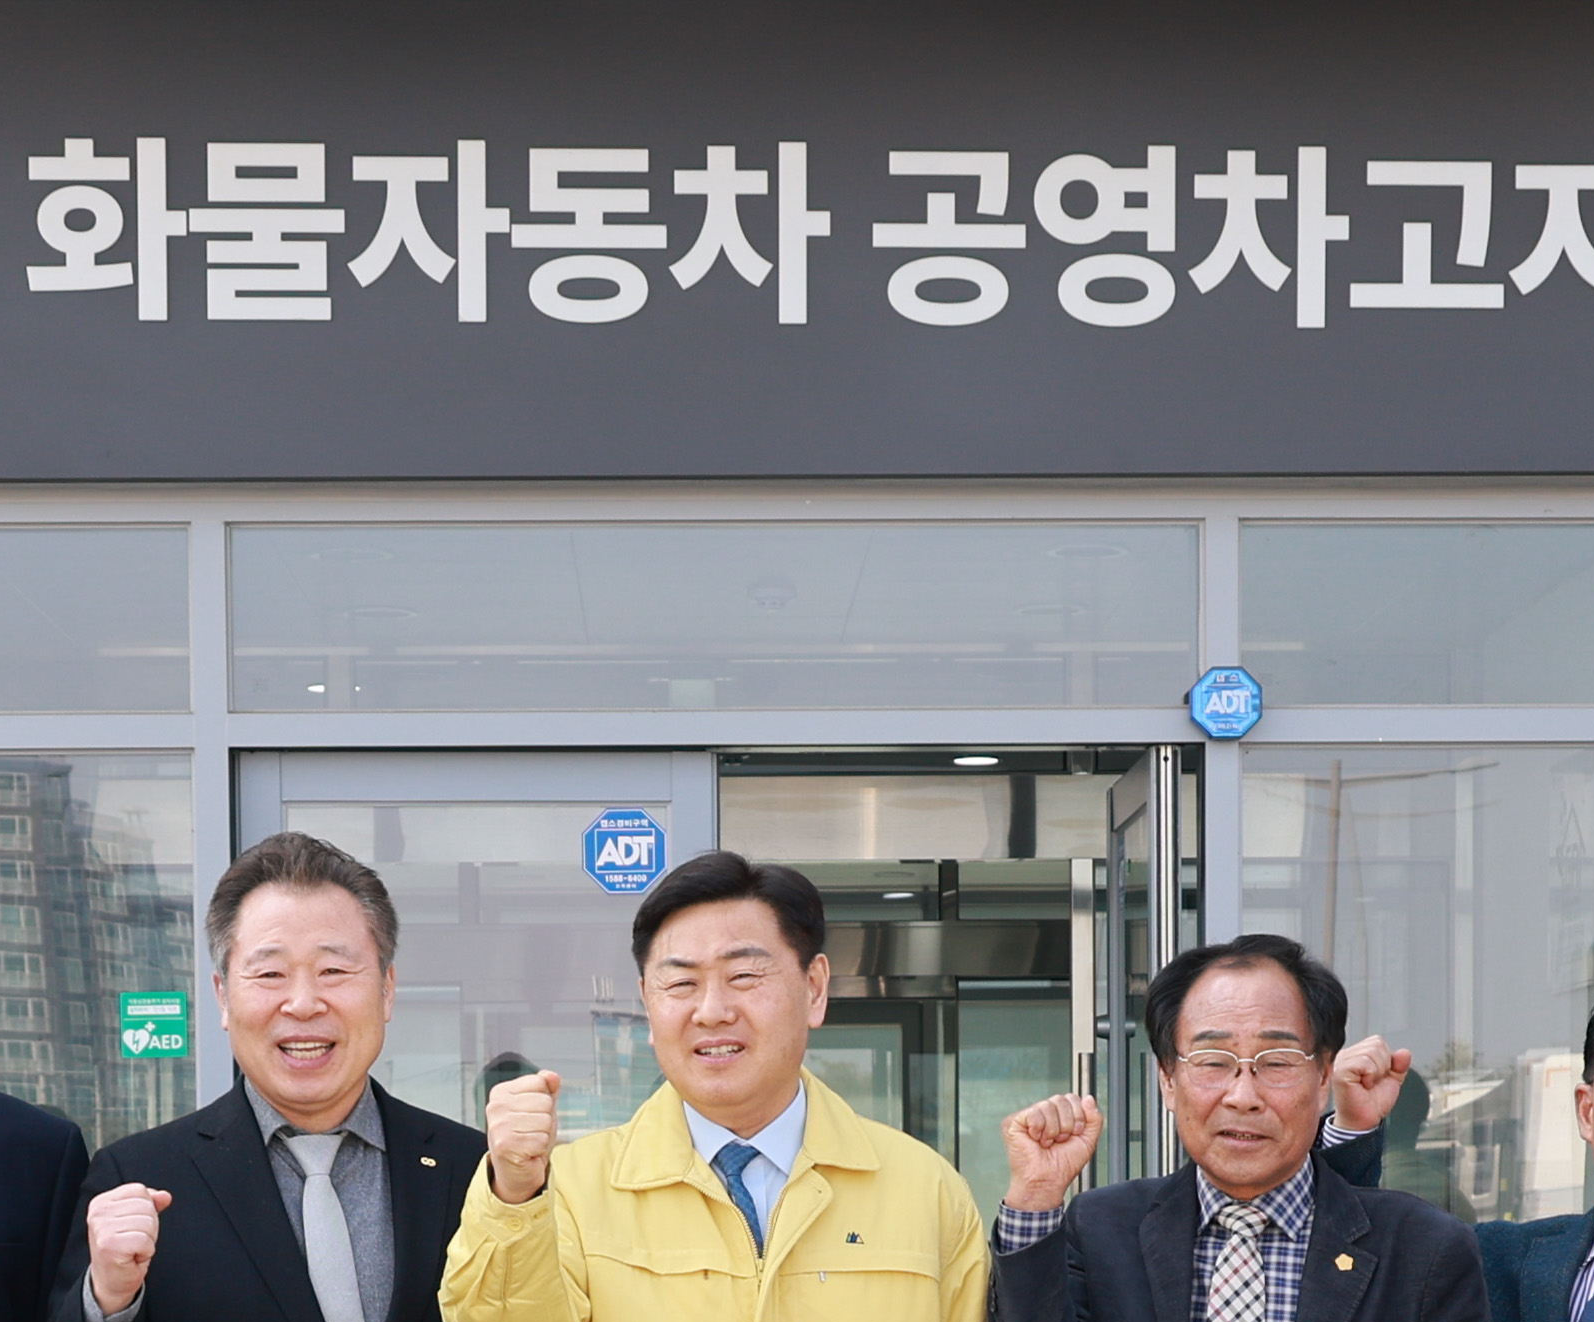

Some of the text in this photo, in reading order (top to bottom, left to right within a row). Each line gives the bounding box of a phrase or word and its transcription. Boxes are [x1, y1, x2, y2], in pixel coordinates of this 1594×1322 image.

[25, 138, 831, 325] 화물자동차
[1204, 690, 1250, 714] ADT
[595, 835, 655, 867] ADT
[148, 1034, 183, 1050] AED
